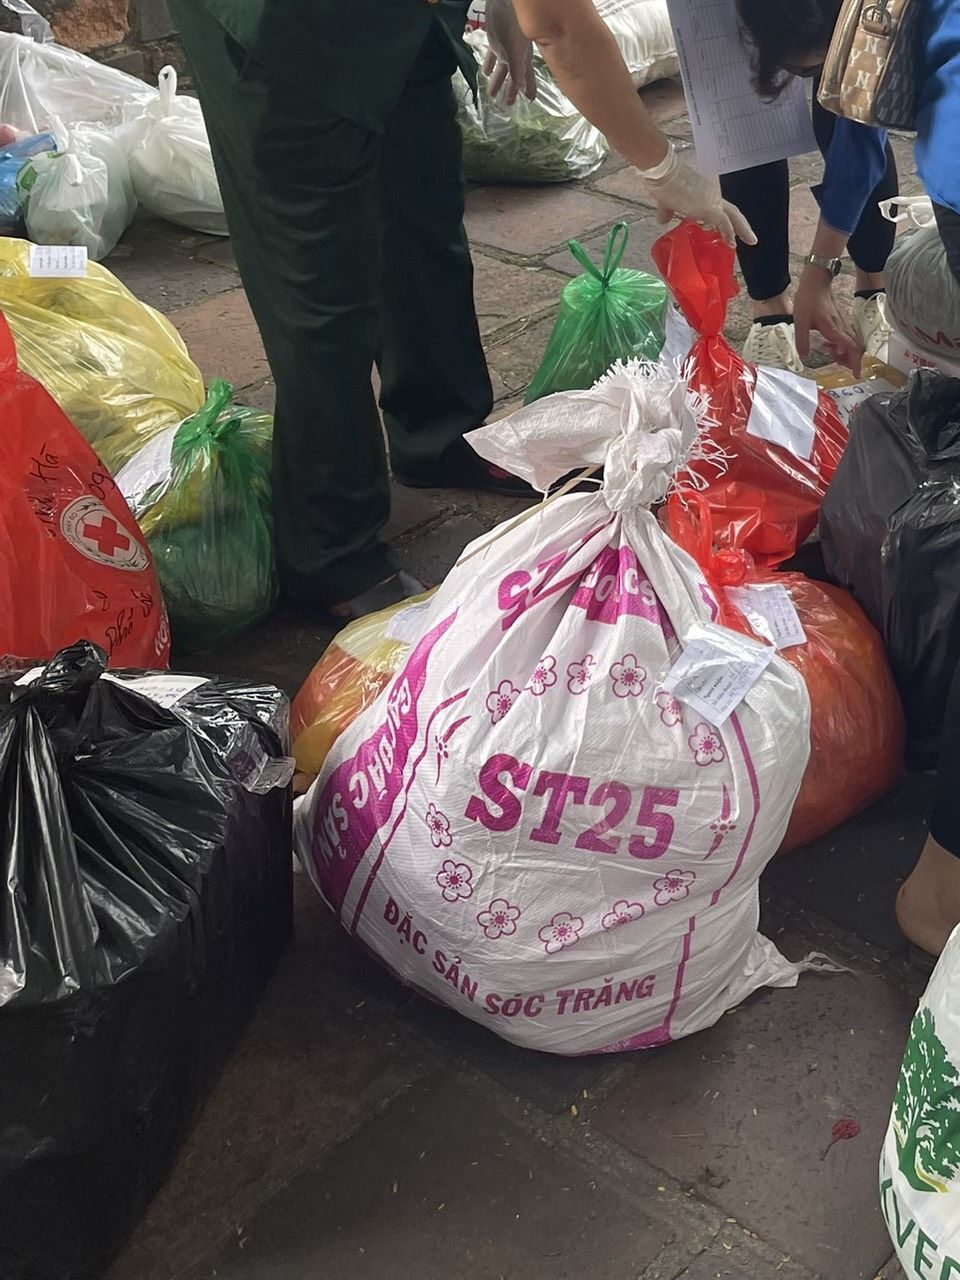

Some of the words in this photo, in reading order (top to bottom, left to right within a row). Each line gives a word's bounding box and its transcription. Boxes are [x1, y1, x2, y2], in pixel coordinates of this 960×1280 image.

[464, 753, 680, 860] ST25
[383, 896, 428, 955] ĐẶC
[432, 949, 479, 1003] SẢN
[481, 992, 545, 1018] SÓC
[555, 974, 656, 1016] TRĂNG
